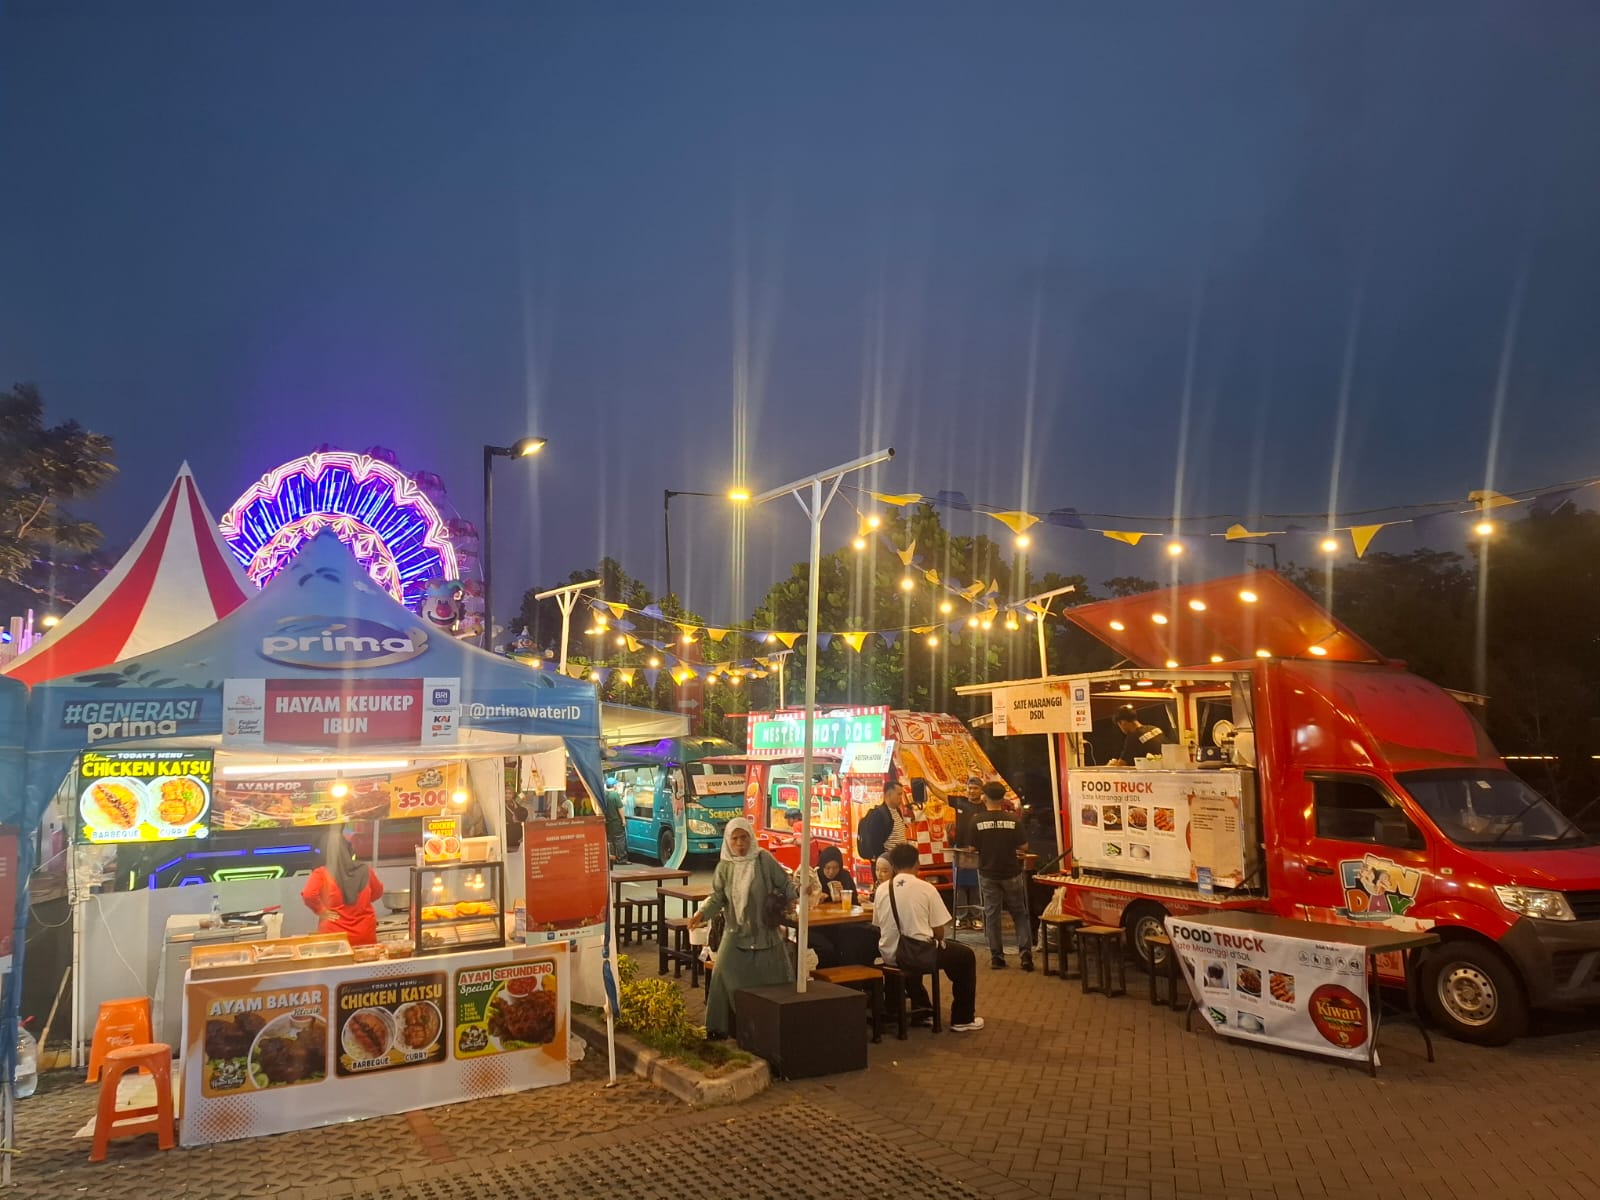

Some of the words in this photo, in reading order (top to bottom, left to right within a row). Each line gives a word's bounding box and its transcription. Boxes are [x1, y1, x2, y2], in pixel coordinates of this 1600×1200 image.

[261, 630, 414, 655] prima
[64, 700, 198, 724] #GENERASI
[275, 697, 340, 713] HAYAM
[346, 696, 414, 712] KEUKEP
[470, 703, 581, 720] @primawaterID
[1013, 700, 1027, 710] SATE
[1027, 697, 1062, 709] MARANGGI
[1029, 711, 1045, 720] DSDL
[88, 718, 177, 743] prima
[323, 718, 368, 734] IBUN
[844, 722, 873, 741] DOG
[82, 762, 154, 777] CHICKEN
[157, 761, 211, 776] KATSU
[1081, 781, 1111, 791] FOOD
[1113, 782, 1153, 793] TRUCK
[1346, 888, 1414, 914] DAY
[1173, 926, 1211, 943] FOOD
[1214, 932, 1265, 952] TRUCK
[1176, 943, 1191, 951] ate
[1192, 945, 1229, 958] Maranggi
[459, 974, 491, 986] AYAM
[494, 963, 552, 980] SERUNDENG
[341, 990, 397, 1009] CHICKEN
[401, 984, 442, 1002] KATSU
[460, 982, 494, 996] Special
[210, 998, 262, 1016] AYAM
[267, 991, 321, 1009] BAKAR
[1316, 1000, 1361, 1019] Kiwari
[352, 1058, 389, 1069] BARBEQUE
